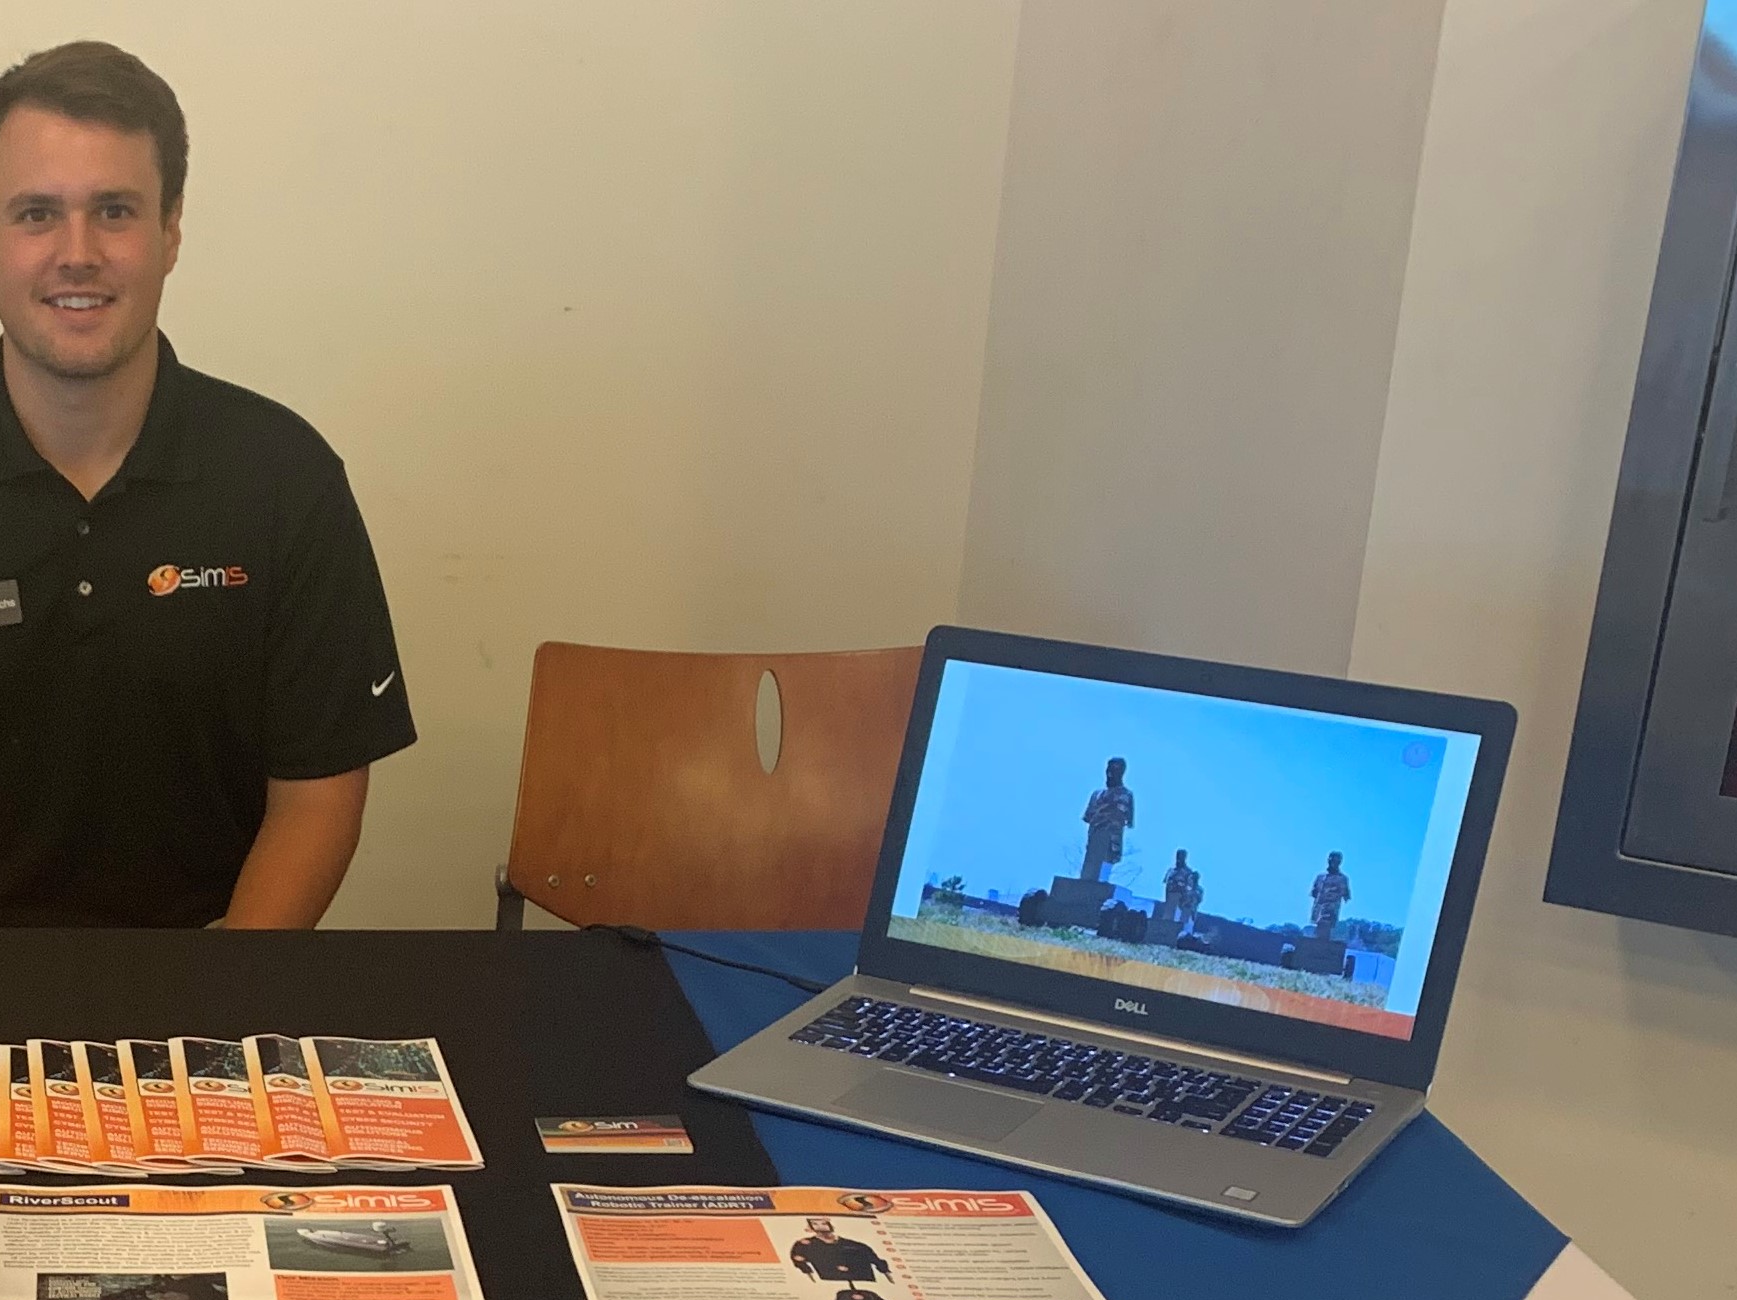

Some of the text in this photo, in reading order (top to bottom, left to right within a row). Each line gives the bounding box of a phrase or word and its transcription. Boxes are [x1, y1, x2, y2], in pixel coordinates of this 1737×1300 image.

[180, 566, 248, 588] SimIS
[1114, 998, 1149, 1015] DELL
[9, 1194, 119, 1205] RiverScout
[574, 1192, 764, 1202] Autonomous De-escalation
[590, 1201, 754, 1210] Robotic Trainer (ADRT)
